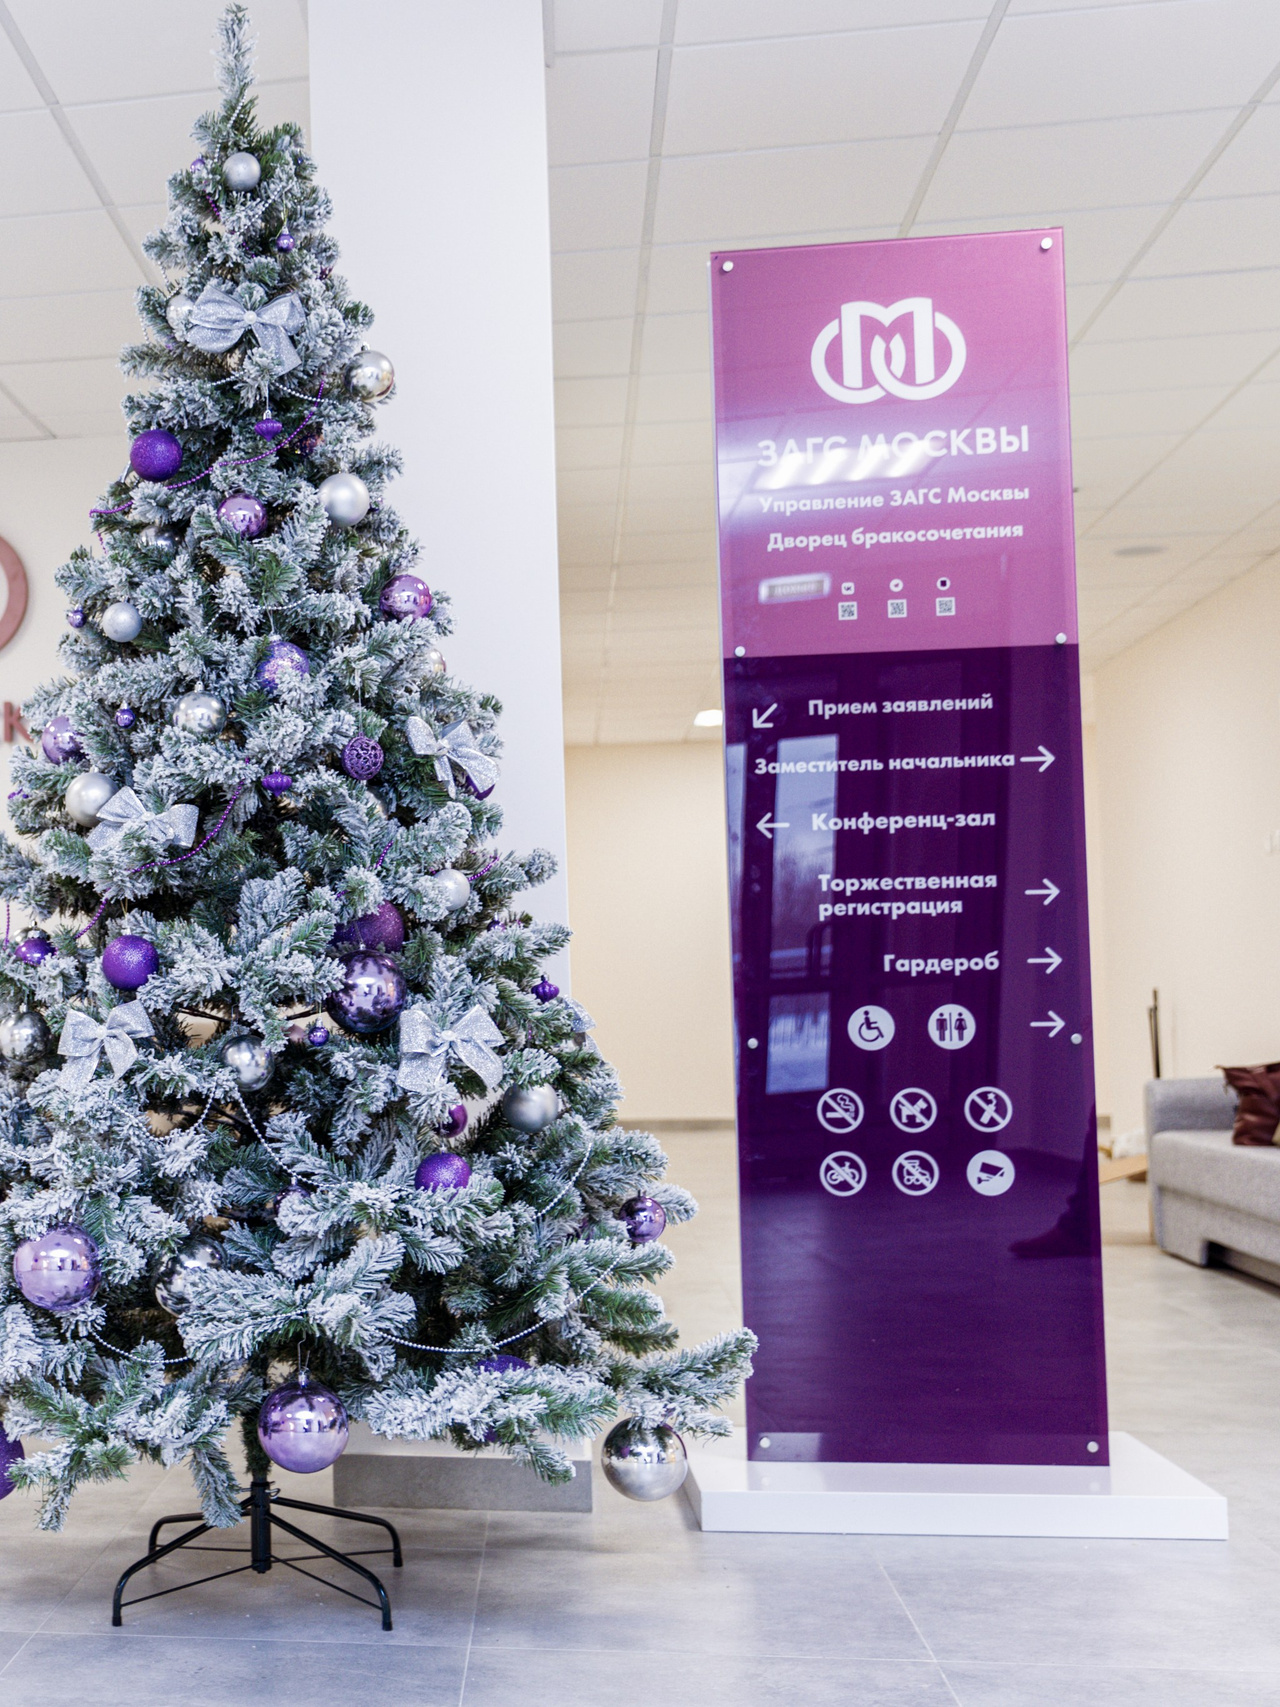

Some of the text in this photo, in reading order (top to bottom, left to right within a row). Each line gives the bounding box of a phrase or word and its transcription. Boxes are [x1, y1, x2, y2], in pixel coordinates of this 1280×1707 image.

[757, 425, 1029, 467] ЗАГС МОСКВЫ
[759, 486, 1029, 516] Управление ЗАГС Москвы
[767, 524, 1023, 552] Дворец бракосочетания
[808, 693, 993, 720] Прием заявлений
[754, 753, 1015, 775] Заместитель начальника
[811, 812, 996, 834] Конференц-зал
[817, 873, 997, 896] Торжественная
[818, 899, 963, 922] регистрация
[883, 950, 1000, 977] Гардероб
